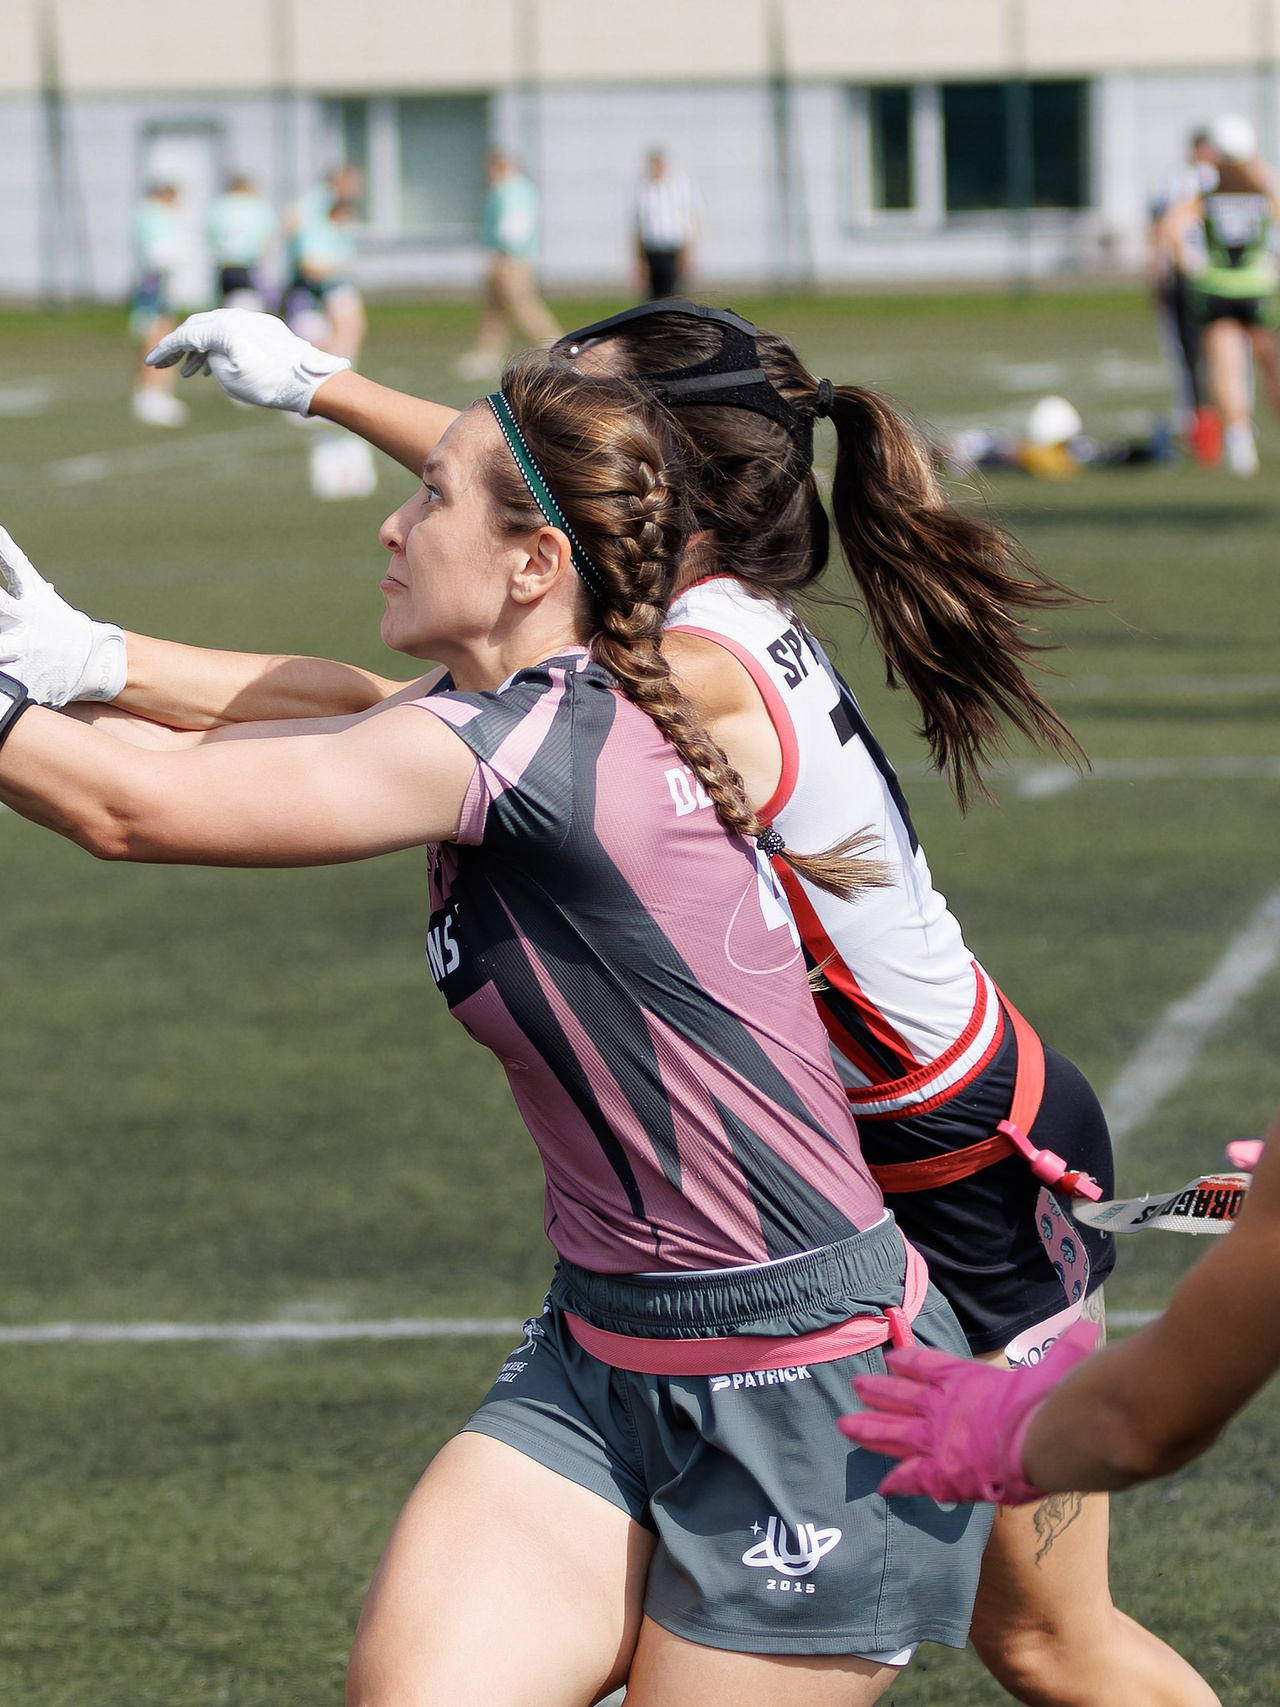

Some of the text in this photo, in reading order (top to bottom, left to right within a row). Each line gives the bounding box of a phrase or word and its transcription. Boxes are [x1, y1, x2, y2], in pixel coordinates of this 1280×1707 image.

[766, 628, 819, 690] SP
[732, 1365, 812, 1390] PATRICK
[766, 1579, 816, 1594] 2015
